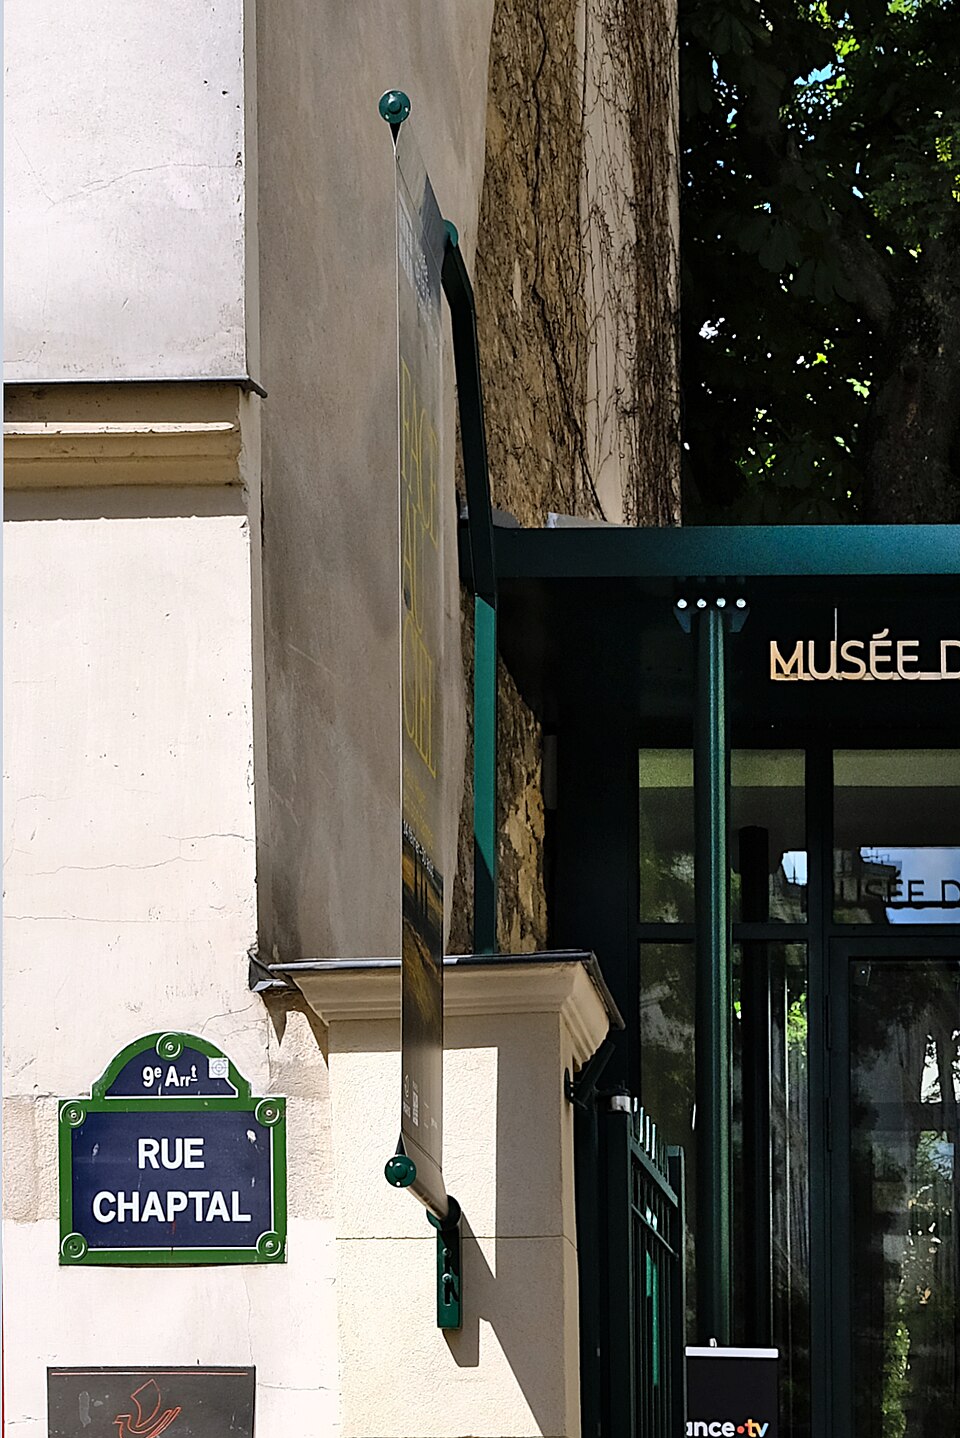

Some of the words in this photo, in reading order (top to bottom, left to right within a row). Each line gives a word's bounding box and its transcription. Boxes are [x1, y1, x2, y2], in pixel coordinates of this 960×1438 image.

[770, 629, 921, 680] MUSÉE
[137, 1138, 205, 1170] RUE
[92, 1190, 252, 1223] CHAPTAL
